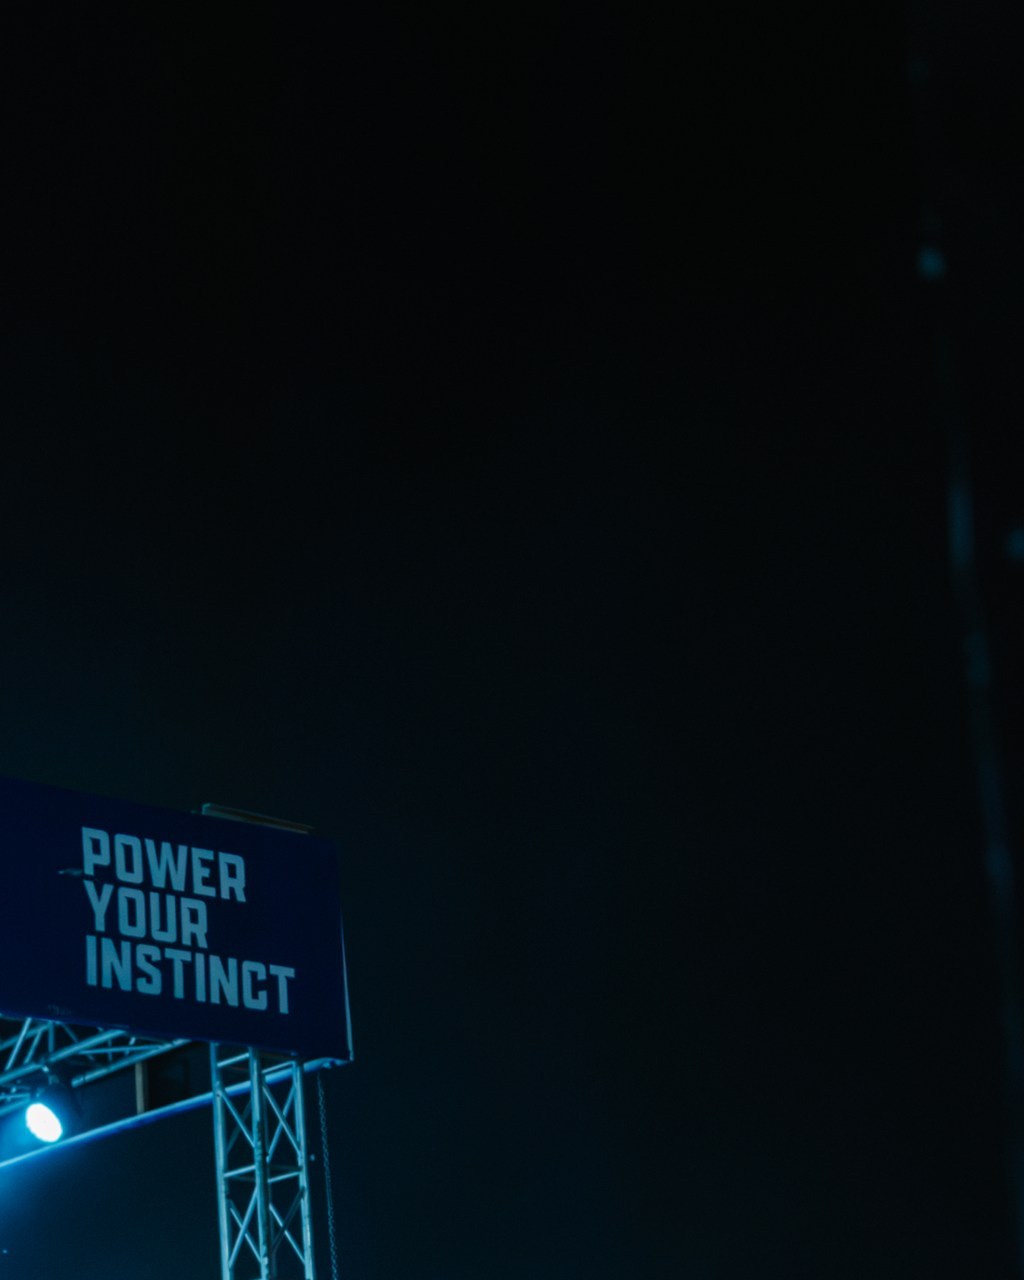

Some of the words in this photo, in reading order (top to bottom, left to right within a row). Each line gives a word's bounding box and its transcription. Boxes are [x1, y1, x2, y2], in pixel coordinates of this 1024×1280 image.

[81, 826, 246, 902] POWER
[83, 880, 208, 948] YOUR
[85, 935, 295, 1014] INSTINCT
